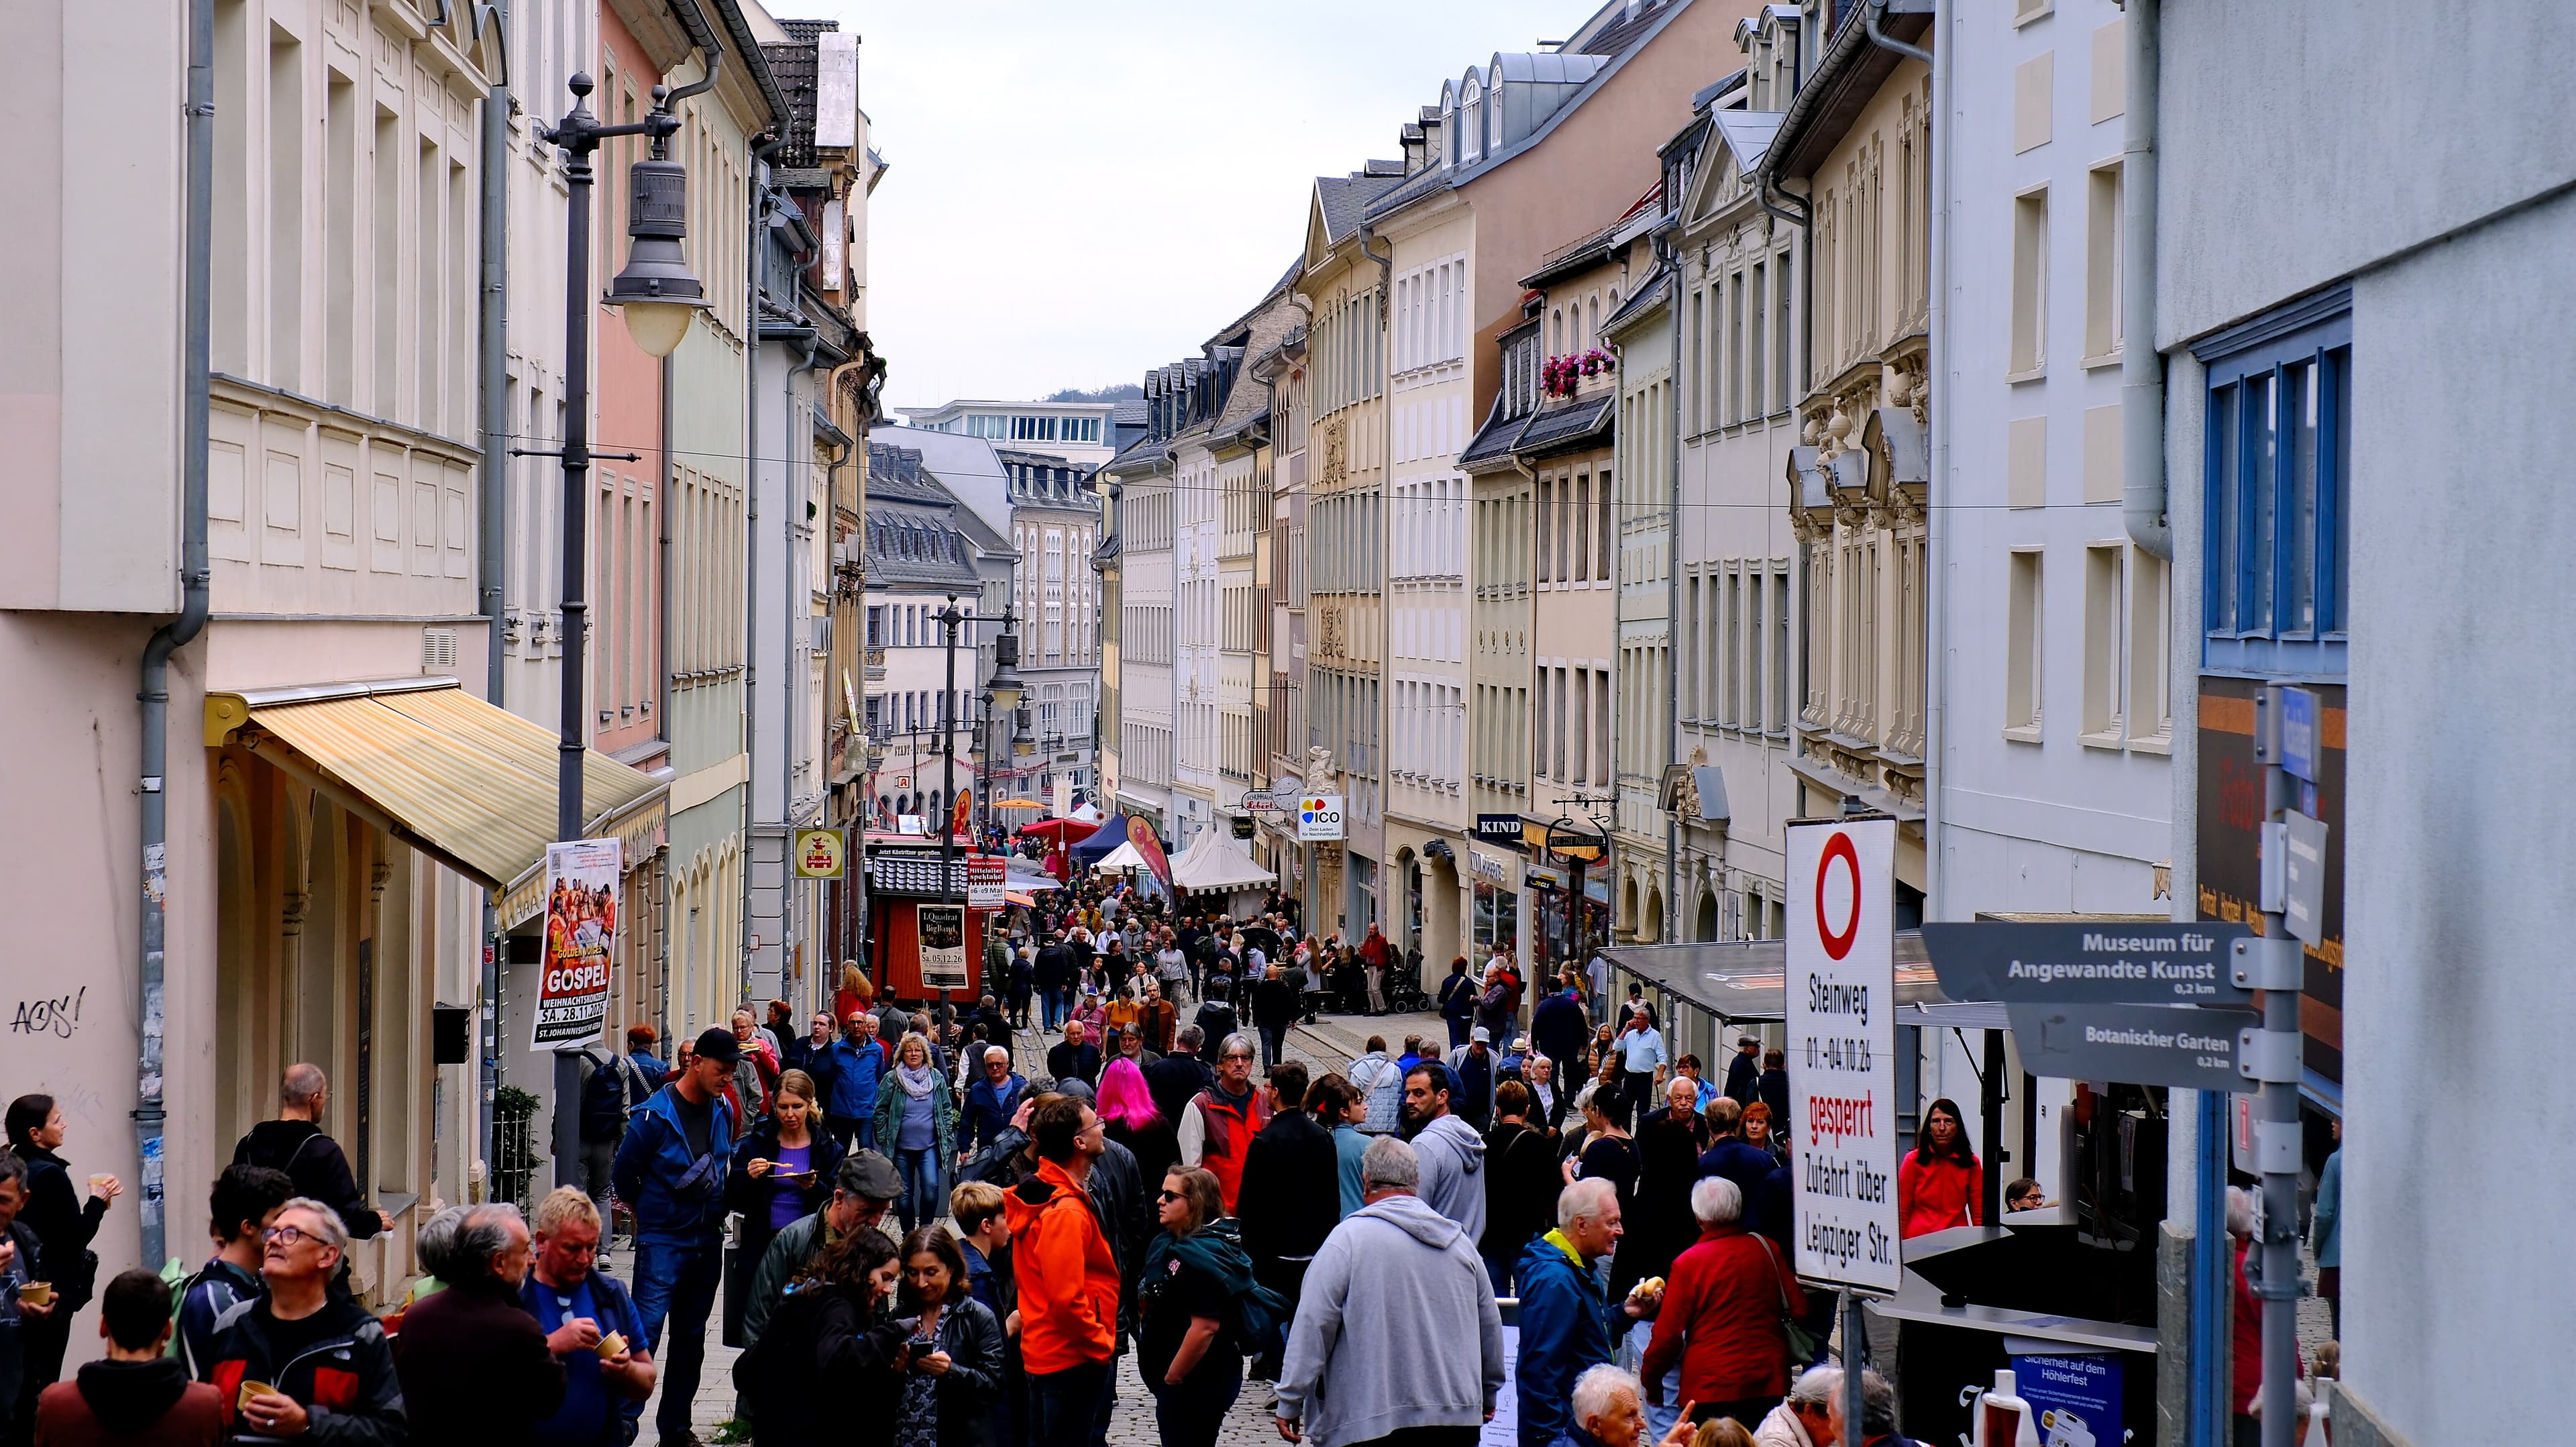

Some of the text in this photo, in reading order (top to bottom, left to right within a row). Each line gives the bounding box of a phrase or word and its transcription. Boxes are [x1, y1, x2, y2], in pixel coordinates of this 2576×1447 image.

[1481, 821, 1521, 833] KIND
[2082, 933, 2214, 953] Museum für
[558, 946, 602, 959] GOLDEN VOICES
[922, 954, 963, 963] Sa. 05.12.26
[547, 964, 606, 992] GOSPEL
[2008, 959, 2215, 983] Angewandte Kunst
[2174, 983, 2215, 996] 0,2 km
[543, 992, 606, 1008] WEIHNACHTSKONZERT
[1809, 972, 1868, 1026] Steinweg
[542, 1002, 603, 1022] SA. 28.11.2026
[549, 1024, 592, 1036] JOHANNISKIRCHE
[2085, 1026, 2230, 1053] Botanischer Garten
[2196, 1057, 2230, 1069] 0,2 km
[1810, 1089, 1874, 1148] gesperrt
[1805, 1153, 1886, 1204] Zufahrt über
[1805, 1211, 1892, 1269] Leipziger Str.
[2070, 1361, 2084, 1371] auf
[2086, 1363, 2105, 1375] dem
[2042, 1369, 2088, 1386] Höhlerfest
